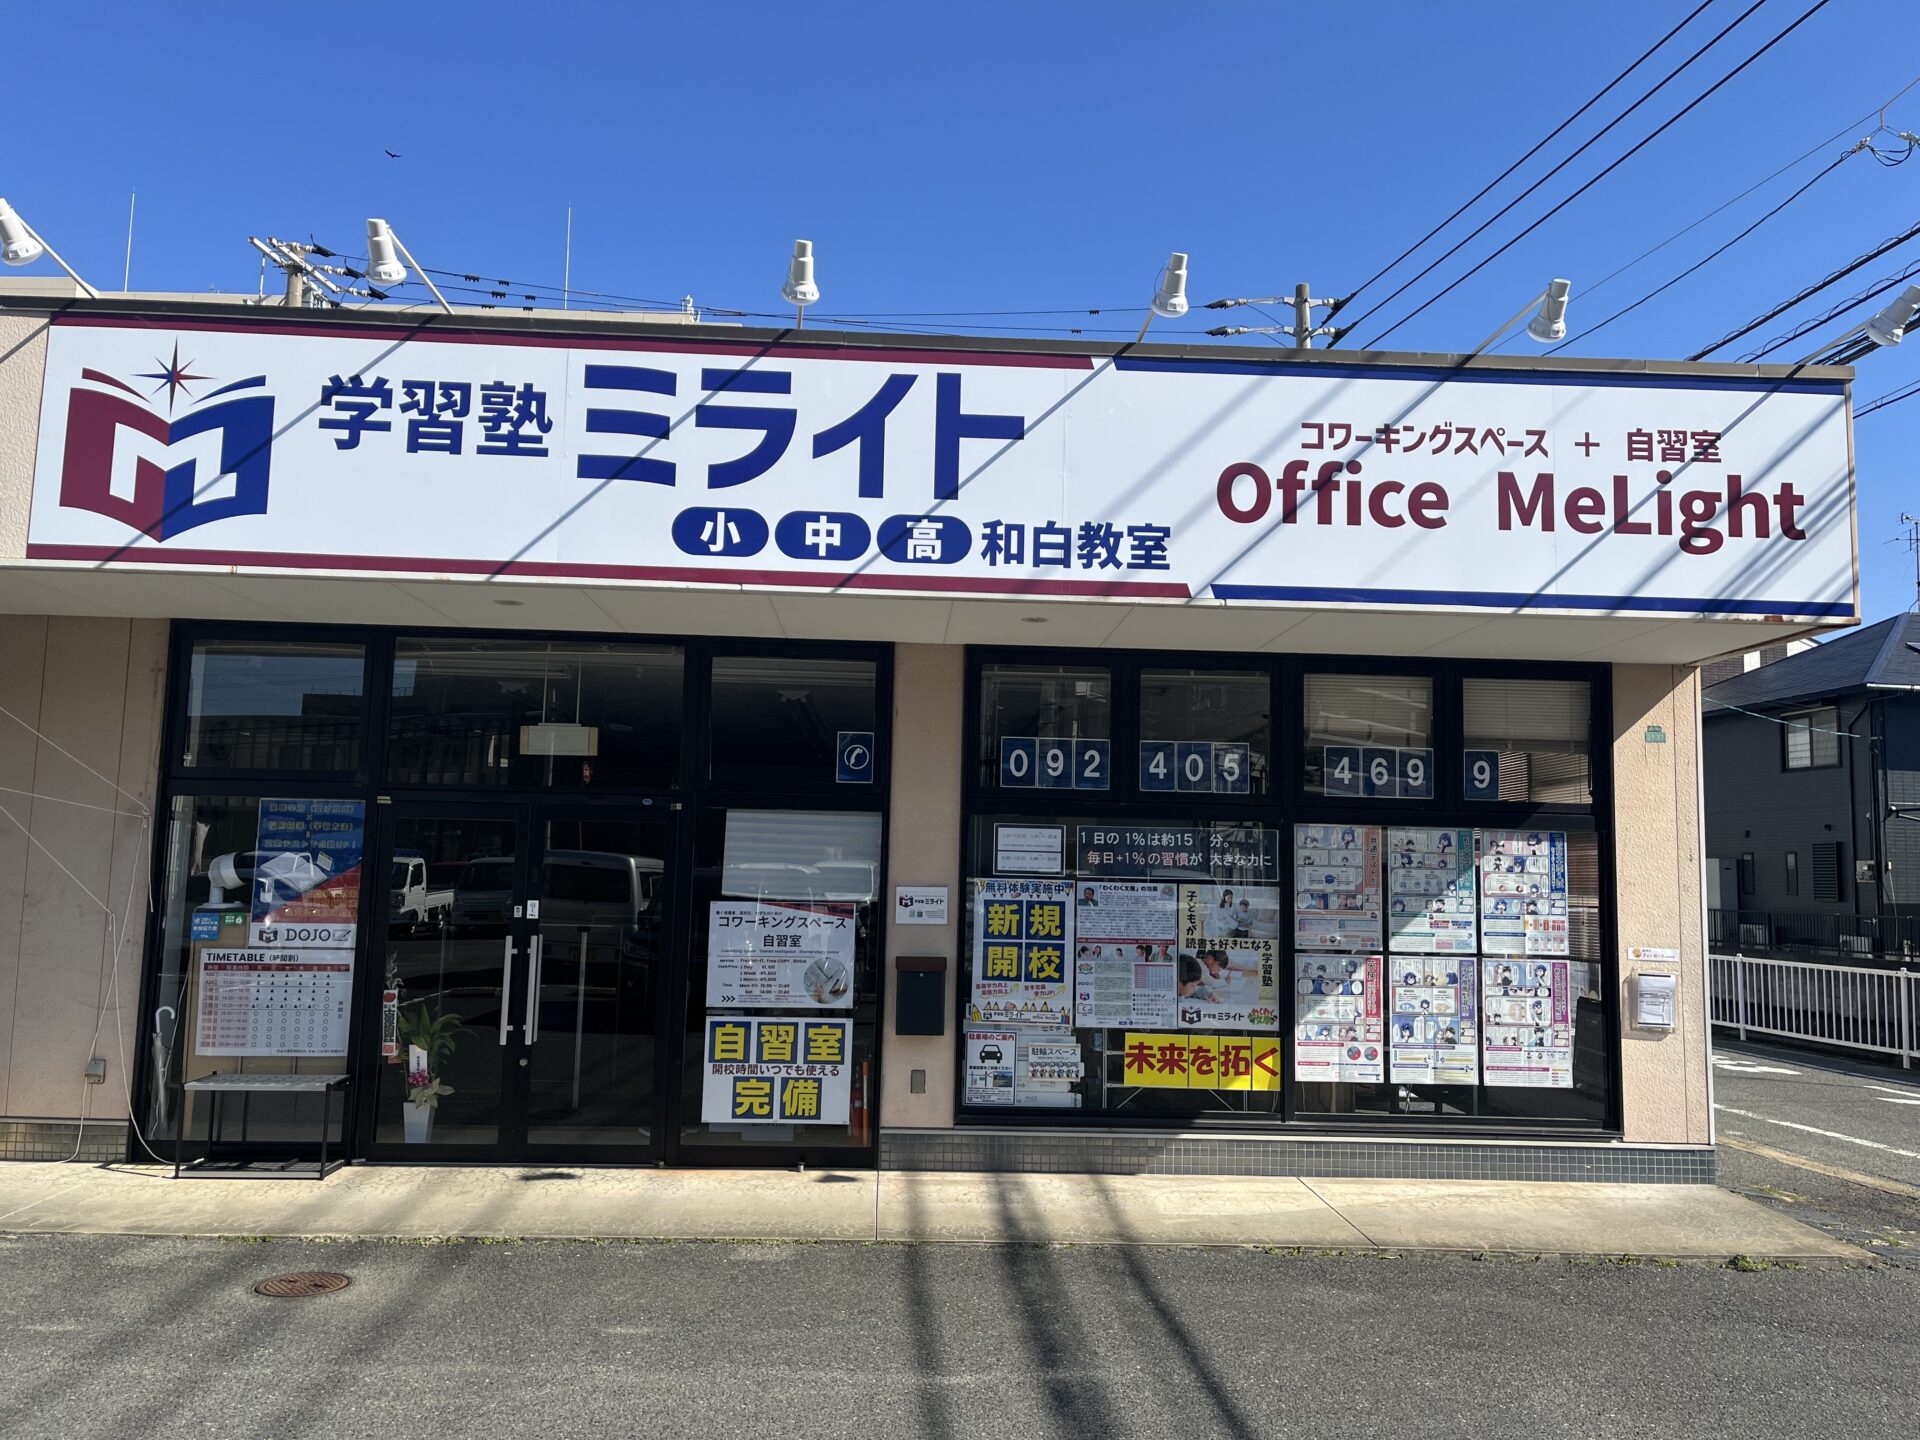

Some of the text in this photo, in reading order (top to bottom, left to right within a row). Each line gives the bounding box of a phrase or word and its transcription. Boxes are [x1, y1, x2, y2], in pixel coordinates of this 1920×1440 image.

[318, 364, 1025, 500] 学習塾 ミライト
[1301, 421, 1549, 459] コワーキングスペース
[1627, 427, 1722, 463] 自習室
[1216, 460, 1807, 556] Office MeLight
[700, 511, 1172, 571] 小 中 高 和白教室
[1009, 748, 1490, 789] 092 405 469 9
[1209, 852, 1273, 867] 大きな力に
[985, 881, 1065, 895] 無料体験実施中
[718, 915, 847, 929] コワーキングスペース
[988, 903, 1062, 937] 新規
[1186, 890, 1198, 936] 子どもが
[285, 928, 331, 941] DOJO
[763, 934, 802, 948] 自習室
[1186, 938, 1272, 952] 読書を好きになる
[206, 952, 265, 962] TIMETABLE
[987, 946, 1061, 980] 開校
[1261, 952, 1273, 987] 学習塾
[1217, 1012, 1245, 1022] ミライト
[714, 1023, 843, 1062] 自習室
[1031, 1047, 1077, 1056] 駐輪スペース
[1125, 1041, 1280, 1078] 未来を拓く
[712, 1063, 840, 1077] 開校時間いつでも使える
[734, 1078, 819, 1117] 完備
